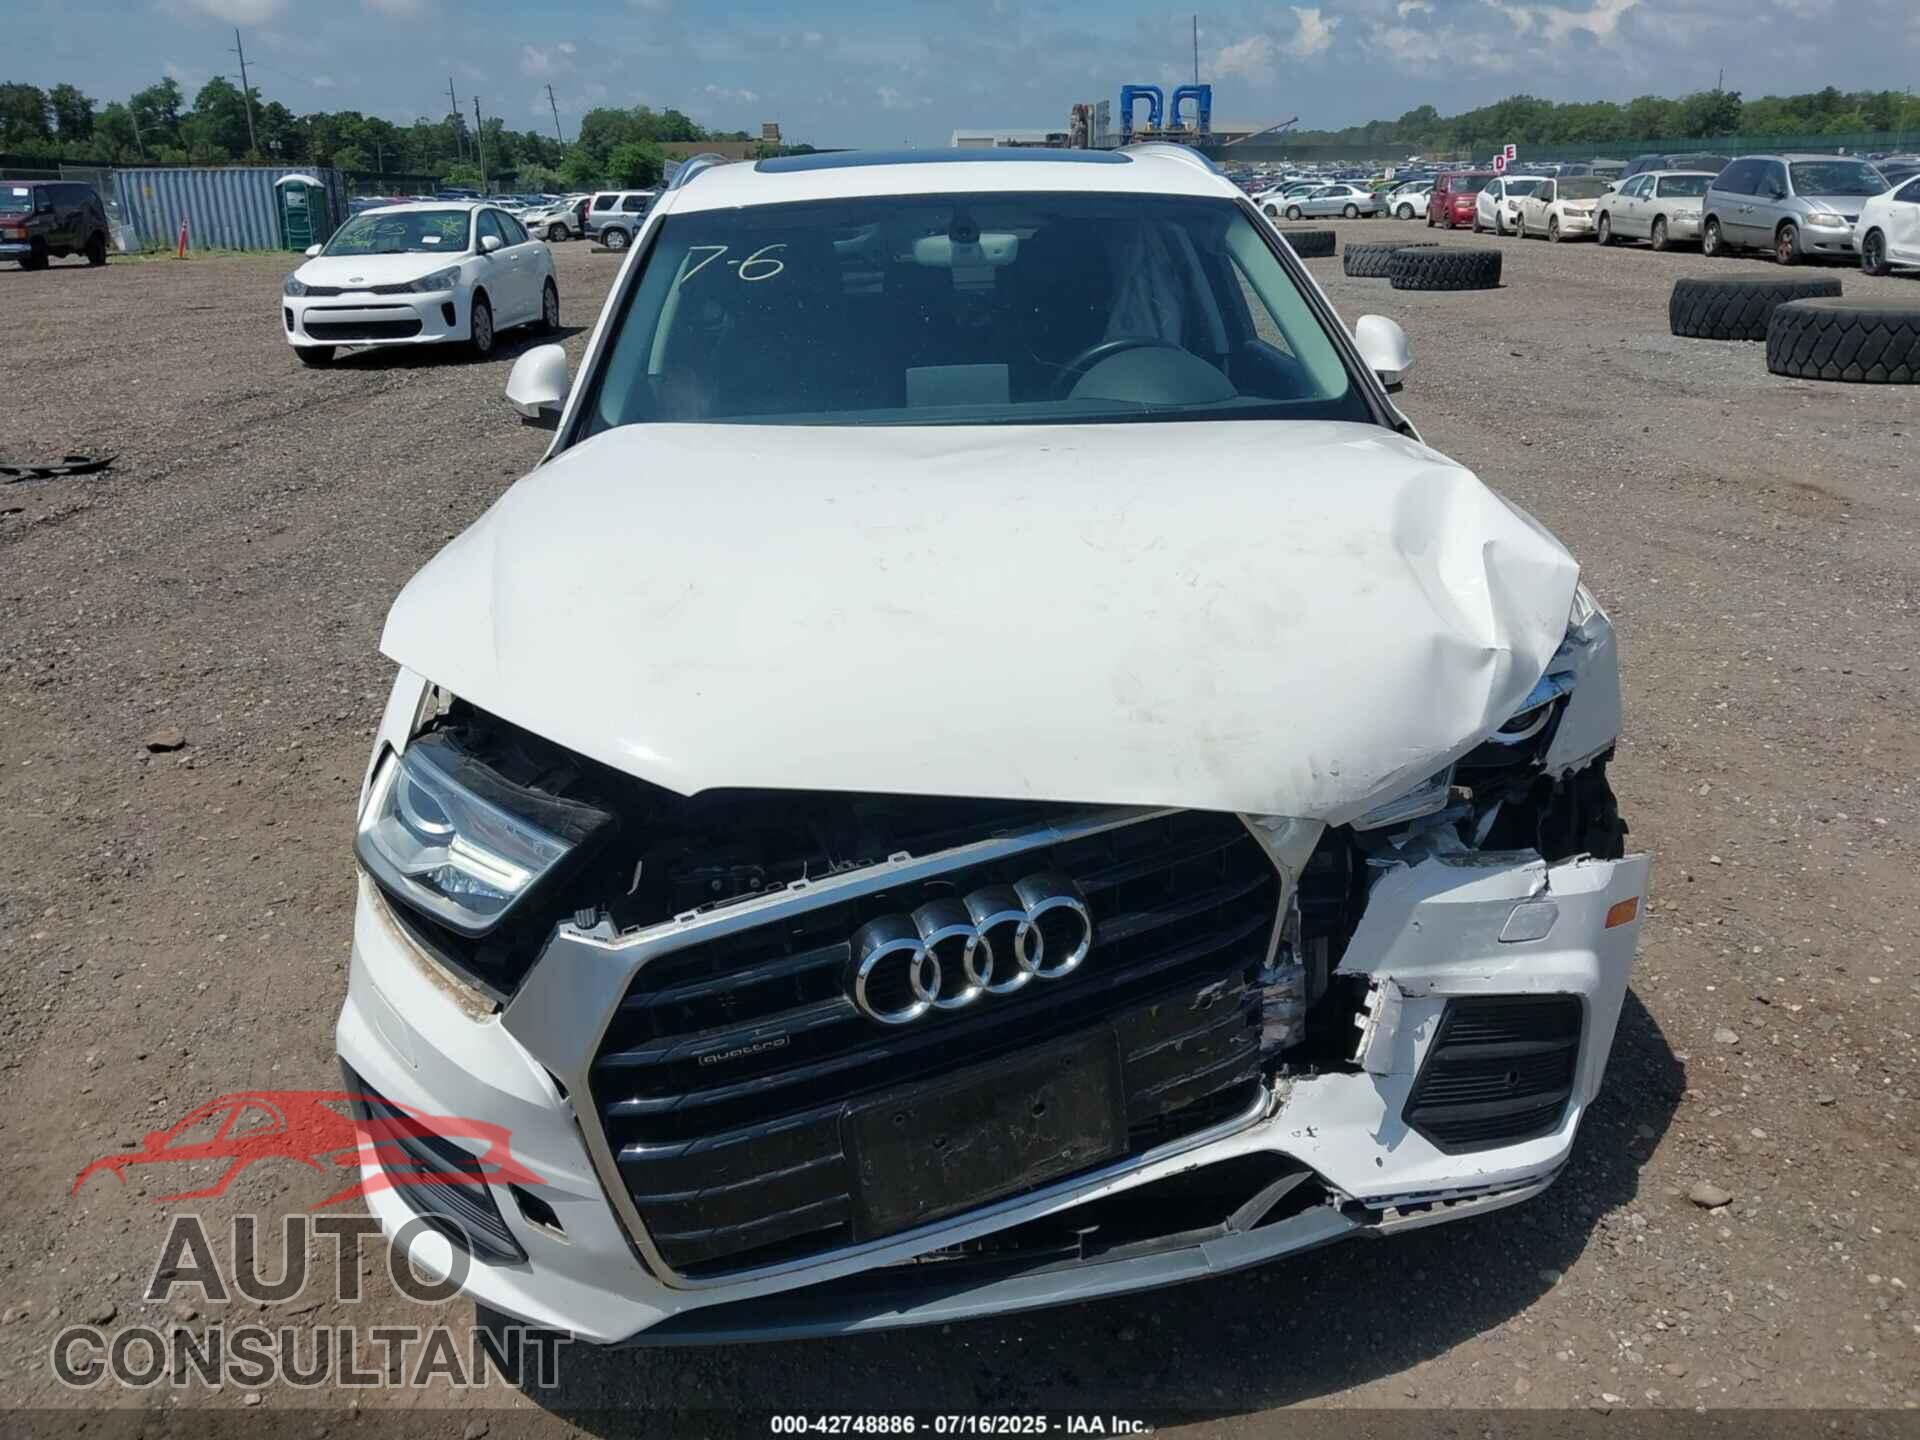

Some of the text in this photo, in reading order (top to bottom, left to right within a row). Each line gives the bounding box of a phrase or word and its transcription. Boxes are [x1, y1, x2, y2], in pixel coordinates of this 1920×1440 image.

[1506, 146, 1514, 159] E
[1496, 156, 1504, 169] D
[702, 1037, 787, 1063] quattro
